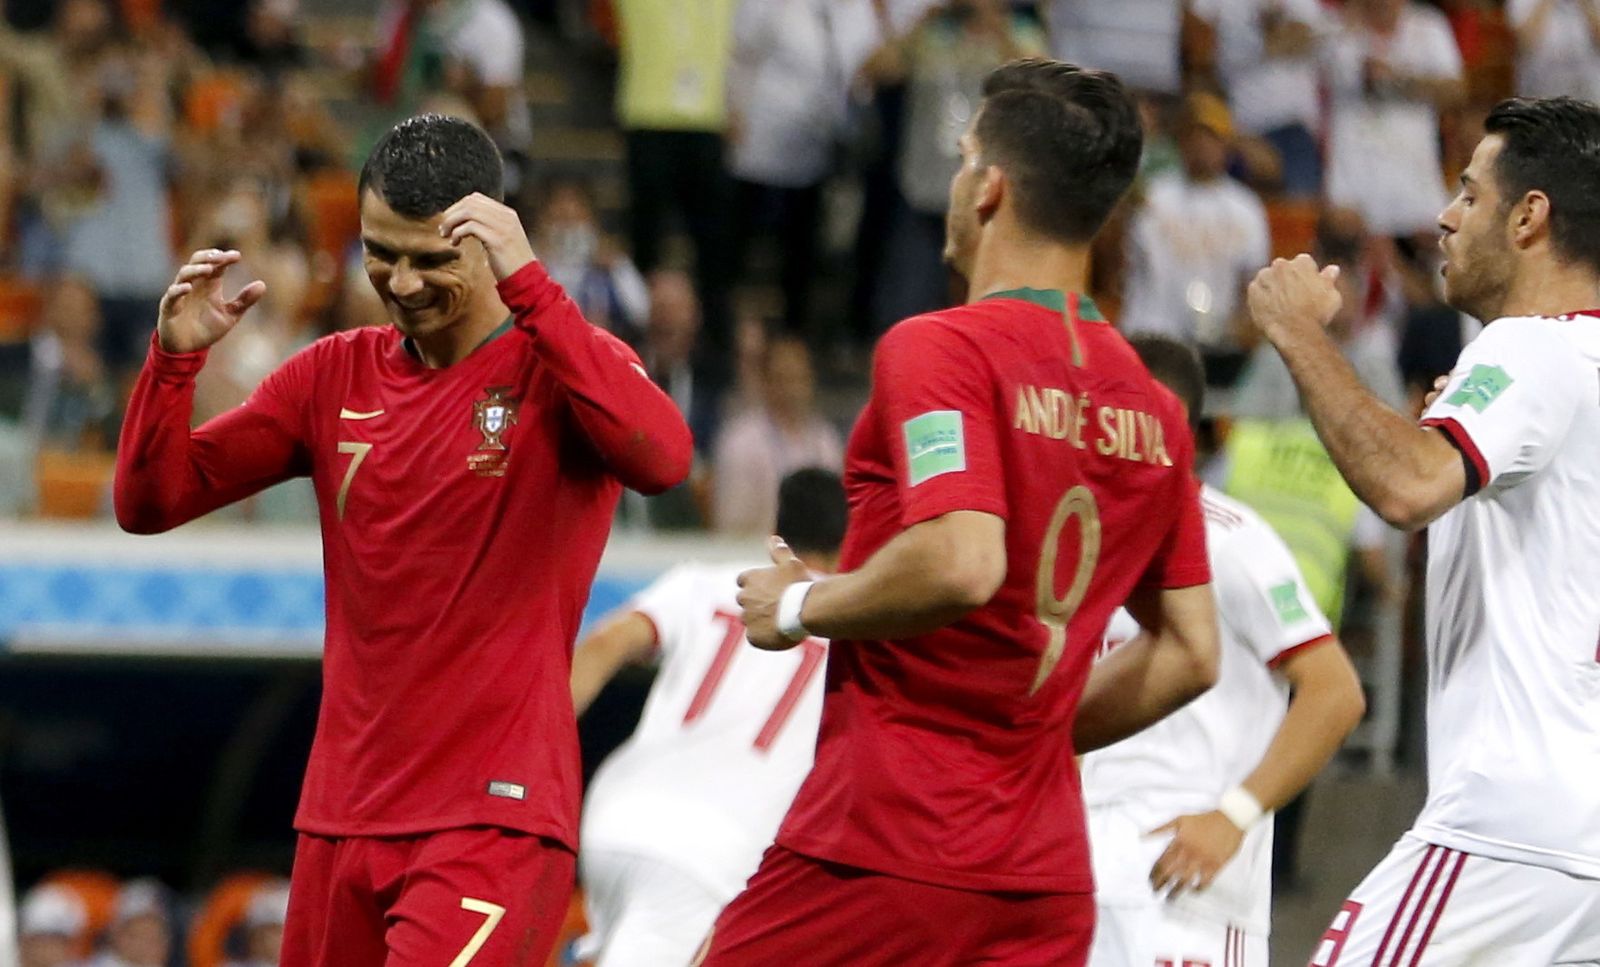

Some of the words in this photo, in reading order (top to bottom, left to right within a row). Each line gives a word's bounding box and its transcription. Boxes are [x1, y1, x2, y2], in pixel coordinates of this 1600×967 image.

[1096, 406, 1173, 467] SILVA
[336, 441, 373, 522] 7
[1029, 485, 1101, 697] 9
[448, 897, 507, 967] 7
